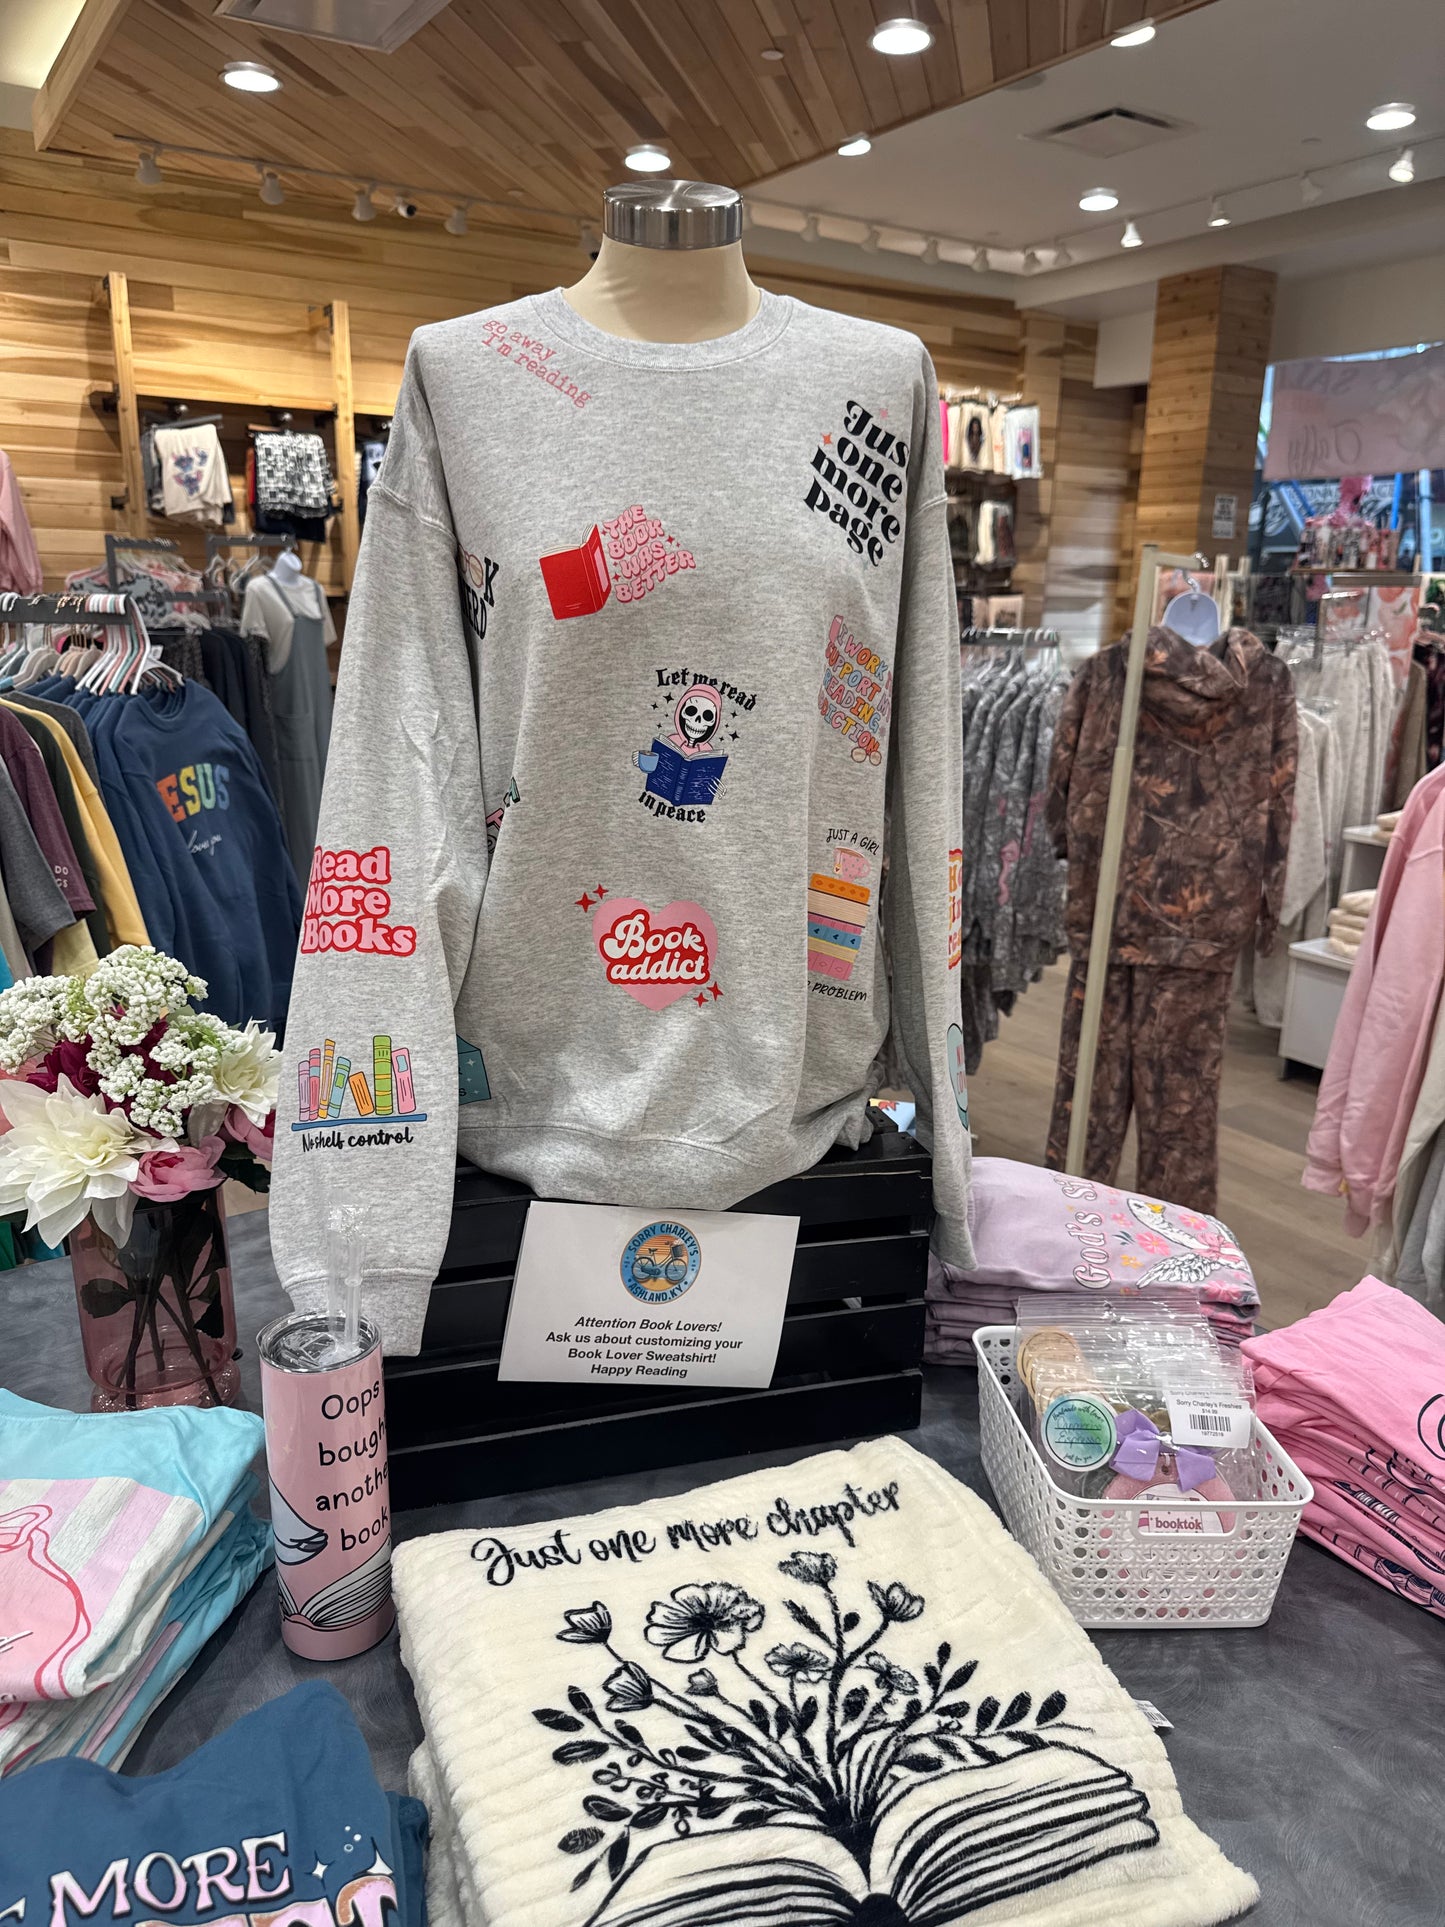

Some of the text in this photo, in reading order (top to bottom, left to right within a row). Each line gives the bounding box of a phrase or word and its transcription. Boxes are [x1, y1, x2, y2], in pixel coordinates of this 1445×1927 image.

[482, 320, 557, 361] go away
[481, 332, 592, 408] I'm reading
[843, 400, 910, 468] Jus
[837, 437, 903, 503] one
[810, 445, 901, 544] more
[603, 505, 647, 539] THE
[607, 519, 665, 560] BOOK
[803, 476, 884, 567] page
[615, 550, 696, 603] BETTER
[620, 541, 666, 579] WAS
[825, 641, 881, 701] SUPPORT
[844, 634, 888, 681] WORK
[655, 668, 758, 711] Let me read
[823, 668, 881, 734] READING
[638, 791, 706, 823] in peace
[826, 828, 880, 856] JUST A GIRL
[311, 847, 391, 884] Read
[306, 884, 391, 918] More
[301, 916, 416, 956] Books
[602, 912, 705, 960] Book
[609, 951, 706, 981] addict
[811, 981, 867, 1001] PROBLEM
[314, 1130, 345, 1150] shelf
[348, 1126, 414, 1147] control
[628, 1223, 699, 1256] SORRY CHARLEY'S
[1065, 1212, 1112, 1289] God's
[545, 1332, 743, 1350] Ask us about customizing your
[574, 1316, 722, 1332] Attention Book Lovers!
[567, 1348, 717, 1363] Book Lover Sweatshirt!
[590, 1364, 688, 1378] Happy Reading
[321, 1380, 380, 1420] Oops
[1176, 1399, 1192, 1407] Sorry
[1193, 1400, 1218, 1408] Charley's
[318, 1417, 386, 1466] bough
[315, 1462, 388, 1512] anothe
[340, 1506, 389, 1551] book
[470, 1480, 900, 1587] Just one more chapter
[1155, 1518, 1203, 1530] booktok
[49, 1830, 292, 1927] MORE
